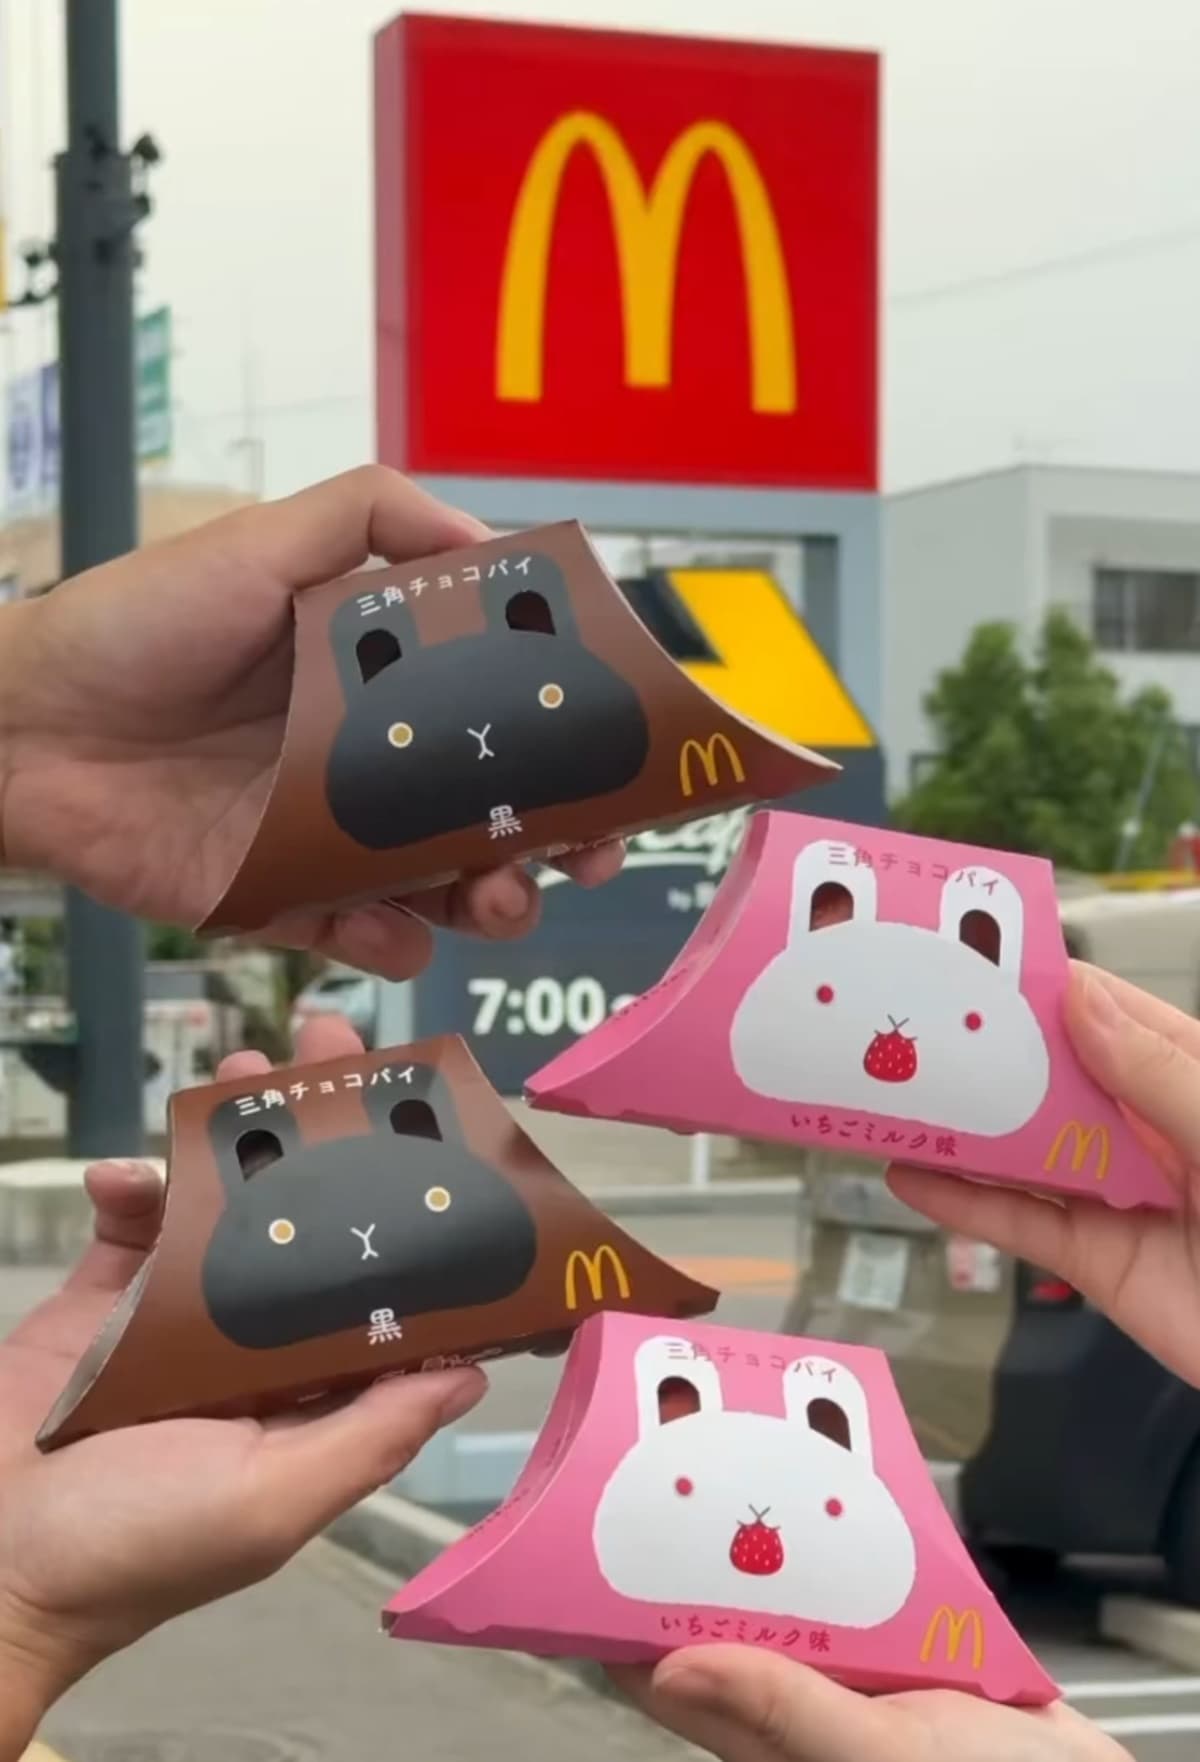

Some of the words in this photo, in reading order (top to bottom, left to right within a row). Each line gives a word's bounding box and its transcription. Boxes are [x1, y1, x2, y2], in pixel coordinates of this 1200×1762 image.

[356, 556, 532, 617] 三角チョコパイ
[488, 804, 523, 840] 黒
[828, 845, 999, 896] 三角チョコパイ
[234, 1065, 415, 1117] 三角チョコパイ
[791, 1113, 957, 1157] いちごミルク味
[367, 1307, 403, 1346] 黒
[660, 1614, 831, 1652] いちごミルク味
